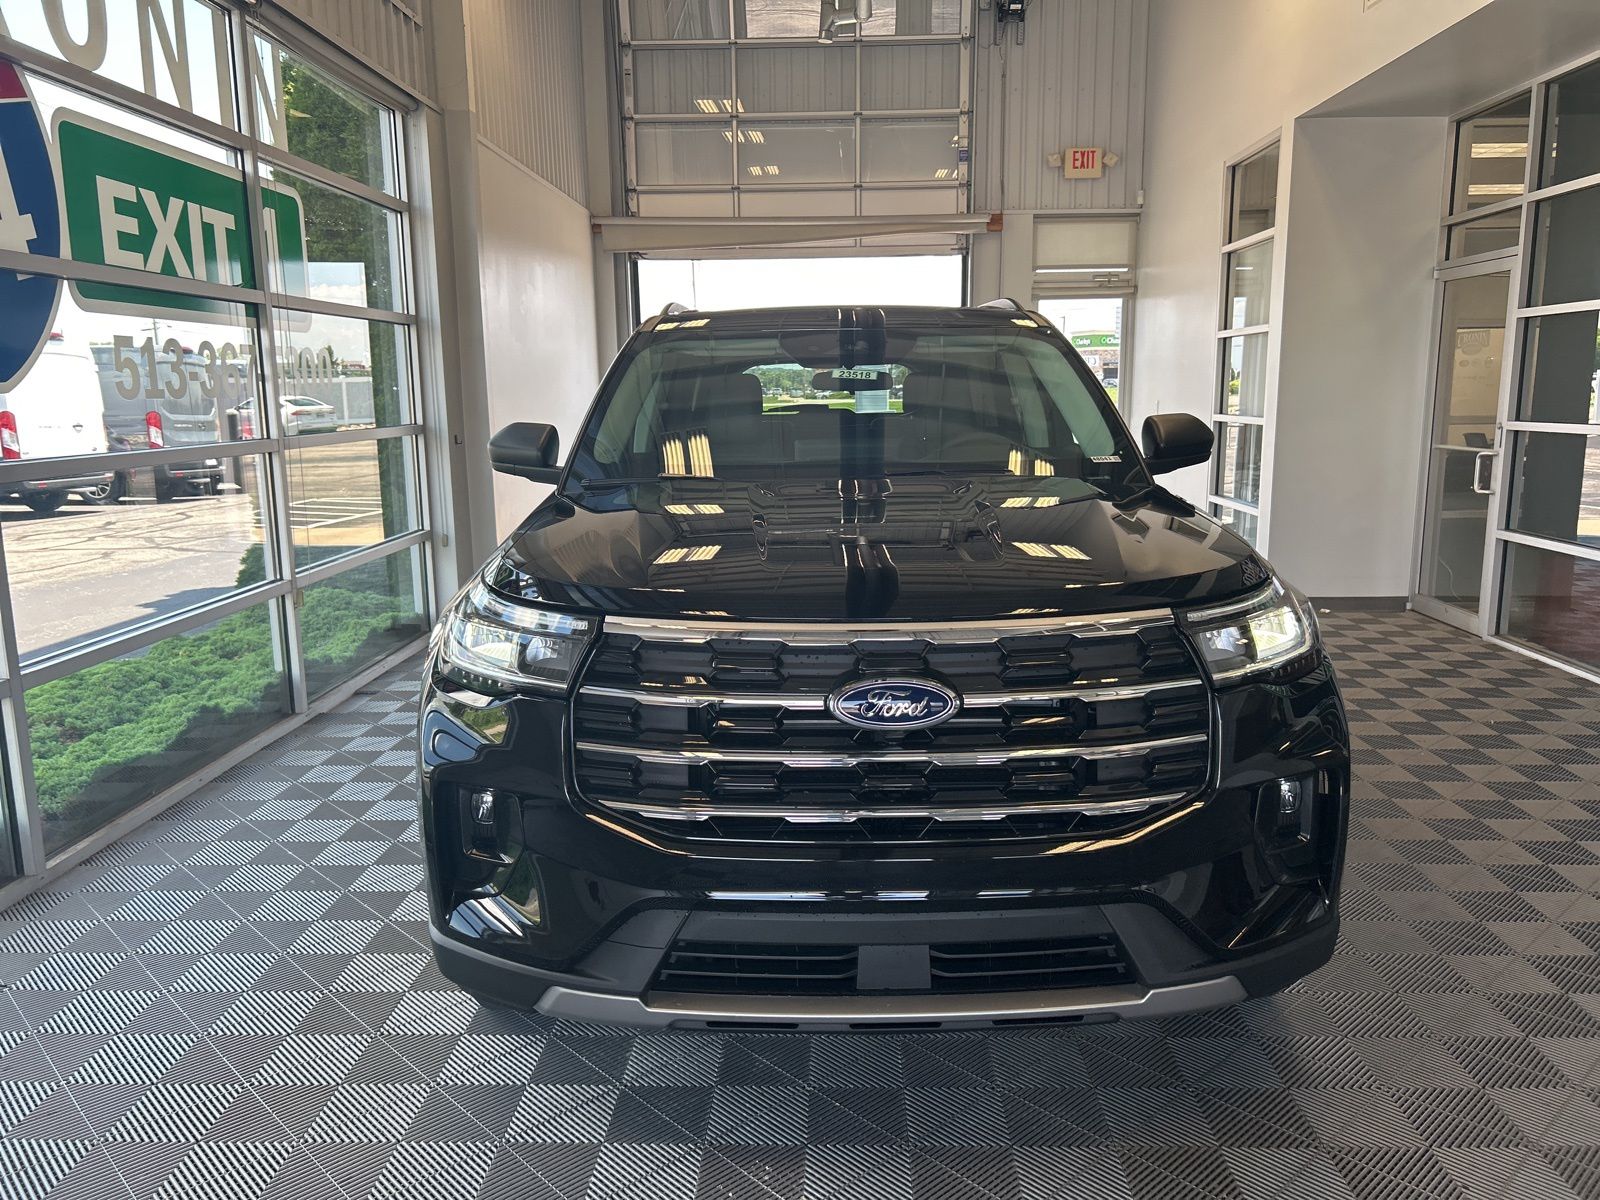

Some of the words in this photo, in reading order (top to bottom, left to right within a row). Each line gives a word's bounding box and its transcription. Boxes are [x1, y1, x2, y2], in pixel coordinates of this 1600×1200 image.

[1072, 150, 1096, 169] EXIT
[96, 175, 243, 287] EXIT
[838, 370, 871, 379] 23518
[861, 689, 928, 717] Ford
